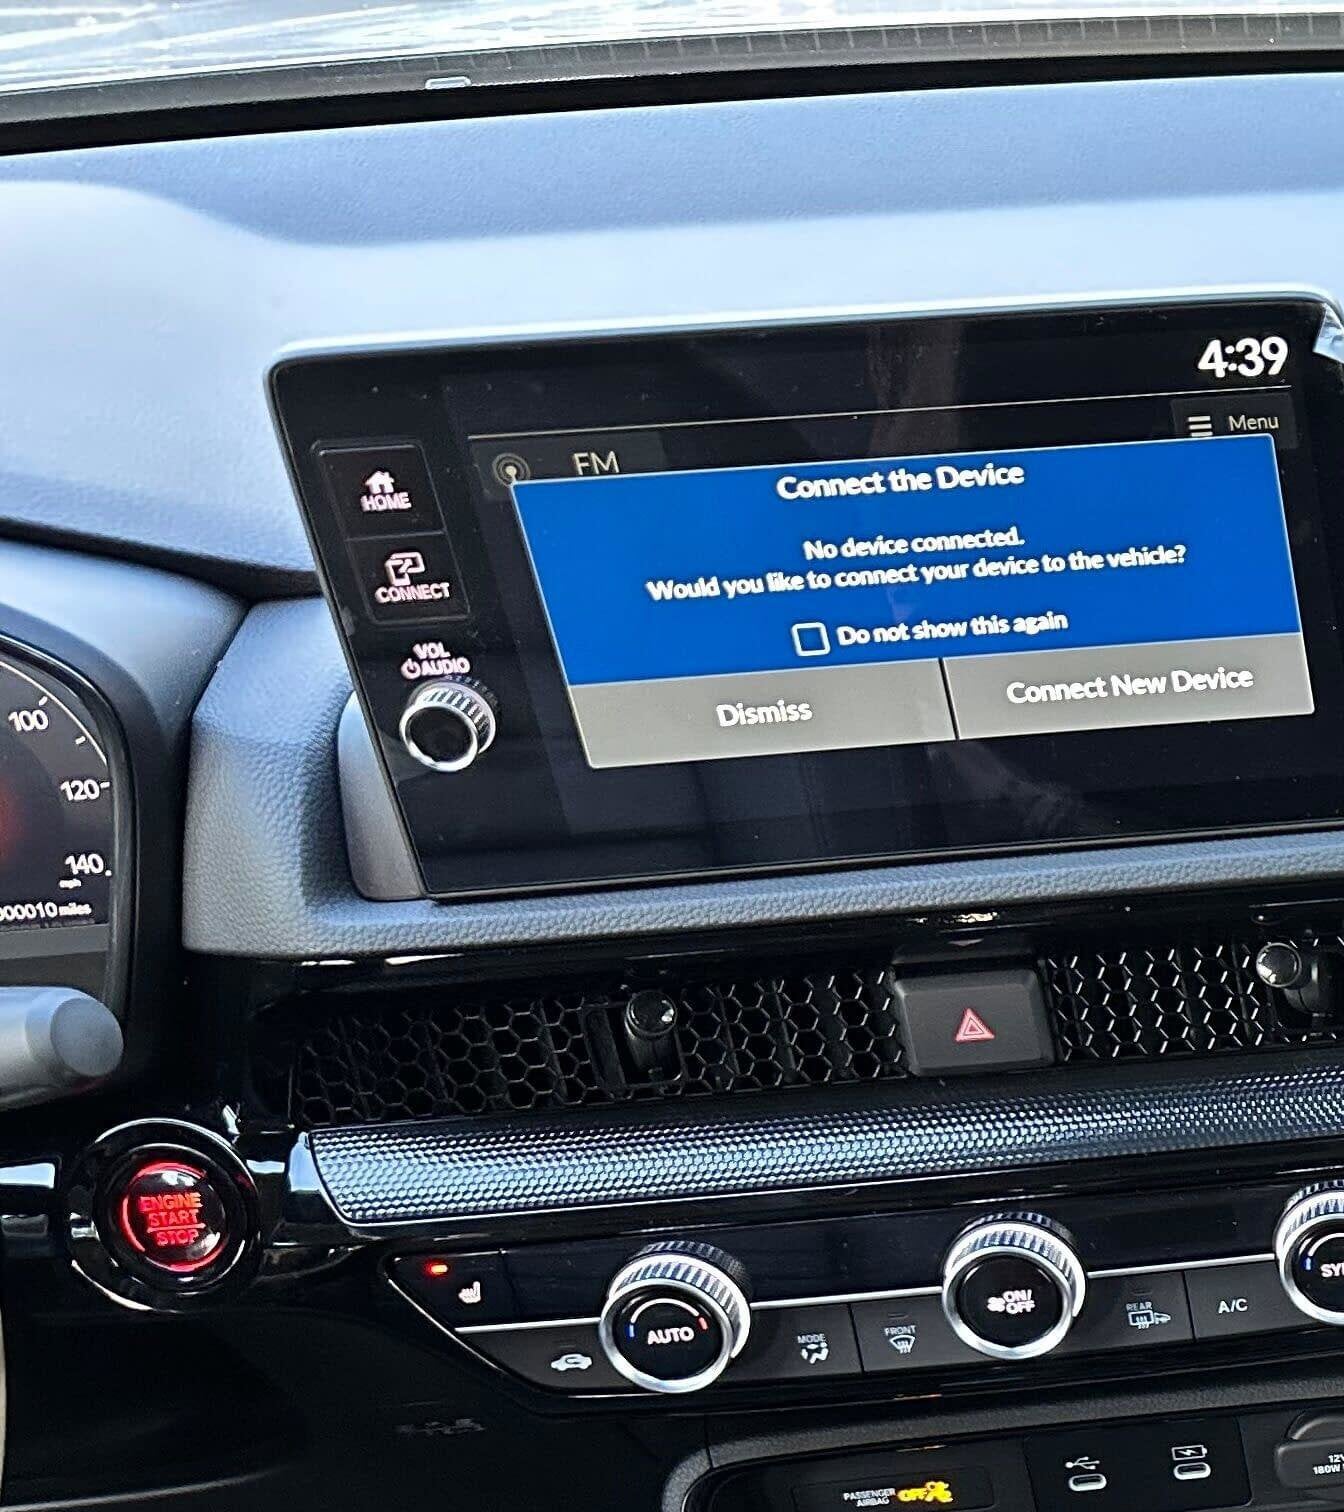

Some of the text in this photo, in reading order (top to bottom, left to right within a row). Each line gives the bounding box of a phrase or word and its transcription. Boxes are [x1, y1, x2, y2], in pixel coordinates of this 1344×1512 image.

[1197, 336, 1289, 378] 4:39
[1229, 414, 1280, 432] Menu
[572, 451, 620, 476] FM
[776, 463, 1025, 500] Connect the Device
[361, 492, 411, 512] HOME
[804, 527, 1025, 560] No device connected.
[645, 544, 1187, 601] Would you like to connect your device to the vehicle?
[375, 582, 449, 603] CONNECT
[837, 612, 1068, 647] Do not show this again
[413, 641, 450, 660] VOL
[421, 657, 471, 676] AUDIO
[1006, 666, 1254, 706] Connect New Device
[9, 709, 48, 733] 100
[715, 699, 812, 729] Dismiss
[60, 779, 100, 801] 120
[65, 854, 104, 875] 140
[139, 1192, 203, 1212] ENGINE
[148, 1209, 199, 1226] START
[157, 1229, 199, 1246] STOP
[1003, 1289, 1032, 1302] ON/
[1006, 1300, 1035, 1314] OFF
[1126, 1301, 1153, 1311] REAR
[1218, 1298, 1248, 1314] A/C
[647, 1327, 694, 1345] AUTO
[797, 1334, 826, 1345] MODE
[884, 1325, 916, 1337] FRONT
[1312, 1463, 1340, 1475] 180W
[843, 1488, 896, 1501] PASSENGER
[856, 1496, 890, 1507] AIRBAG
